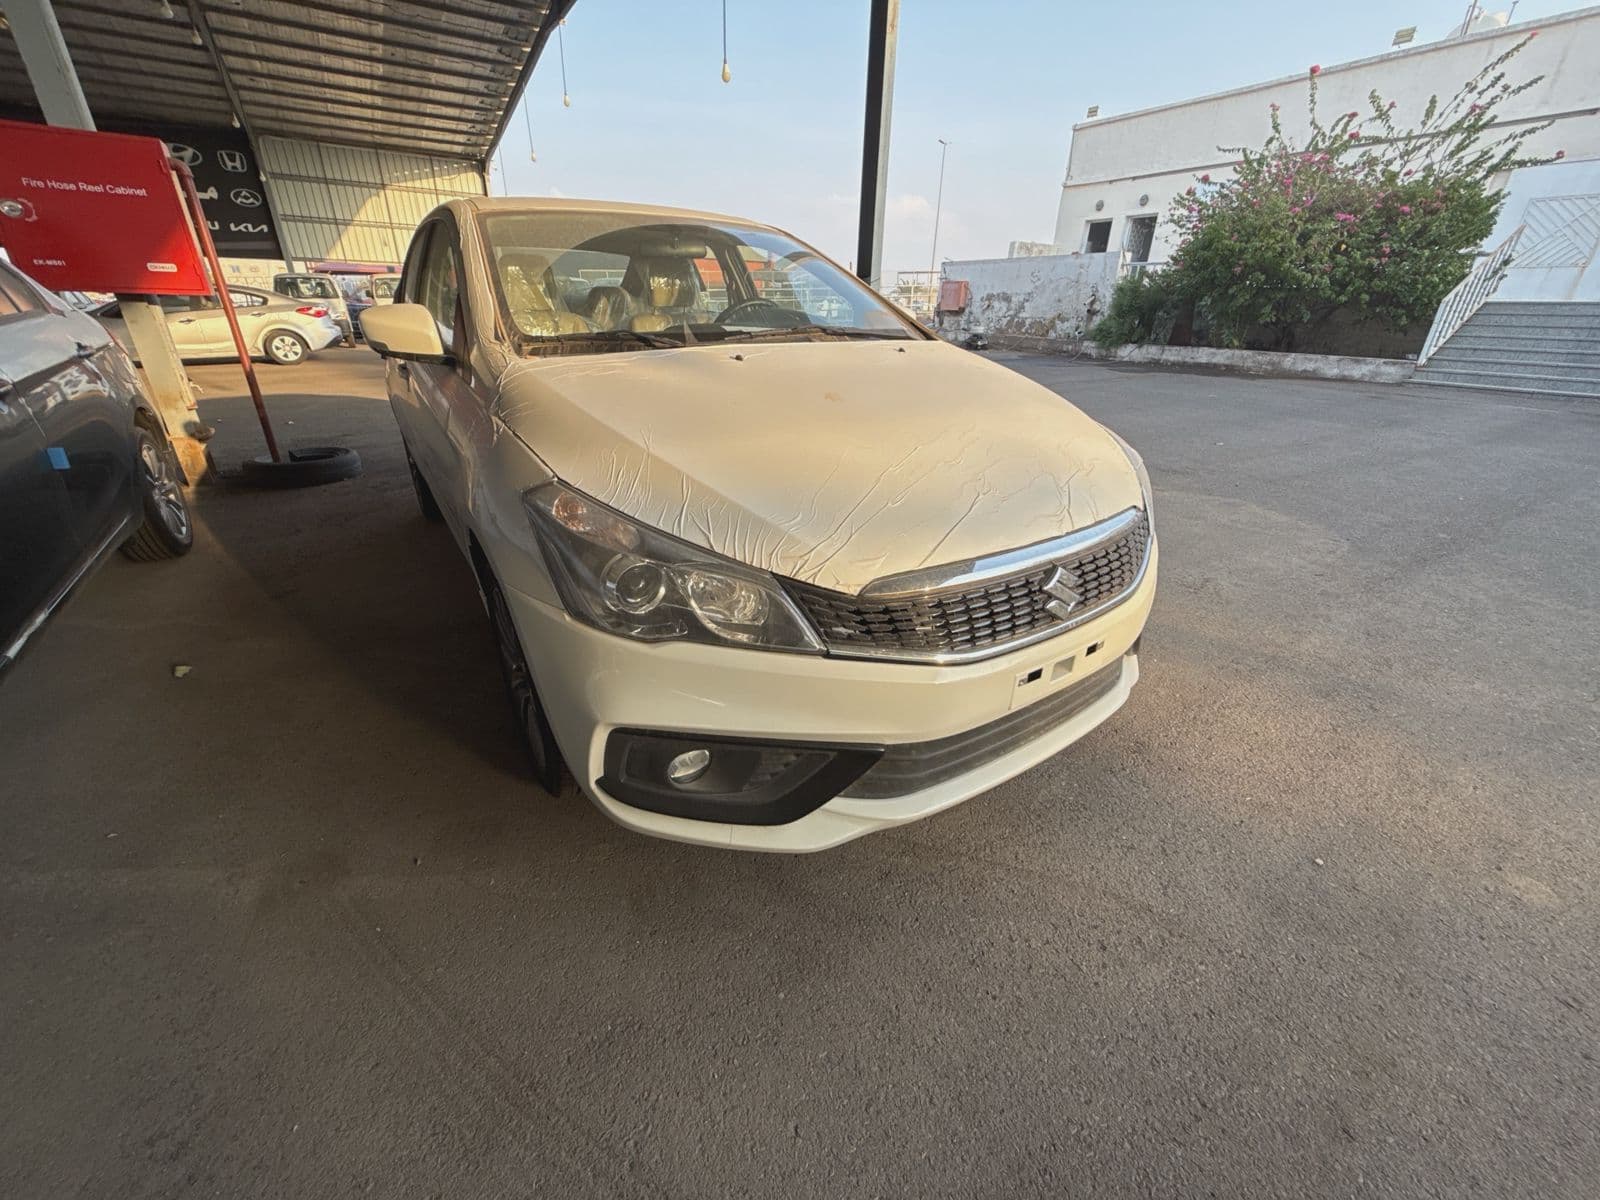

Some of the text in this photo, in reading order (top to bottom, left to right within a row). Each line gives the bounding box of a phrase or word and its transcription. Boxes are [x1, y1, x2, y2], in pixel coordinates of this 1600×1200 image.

[21, 177, 148, 197] Fire Hose Reel Cabinet
